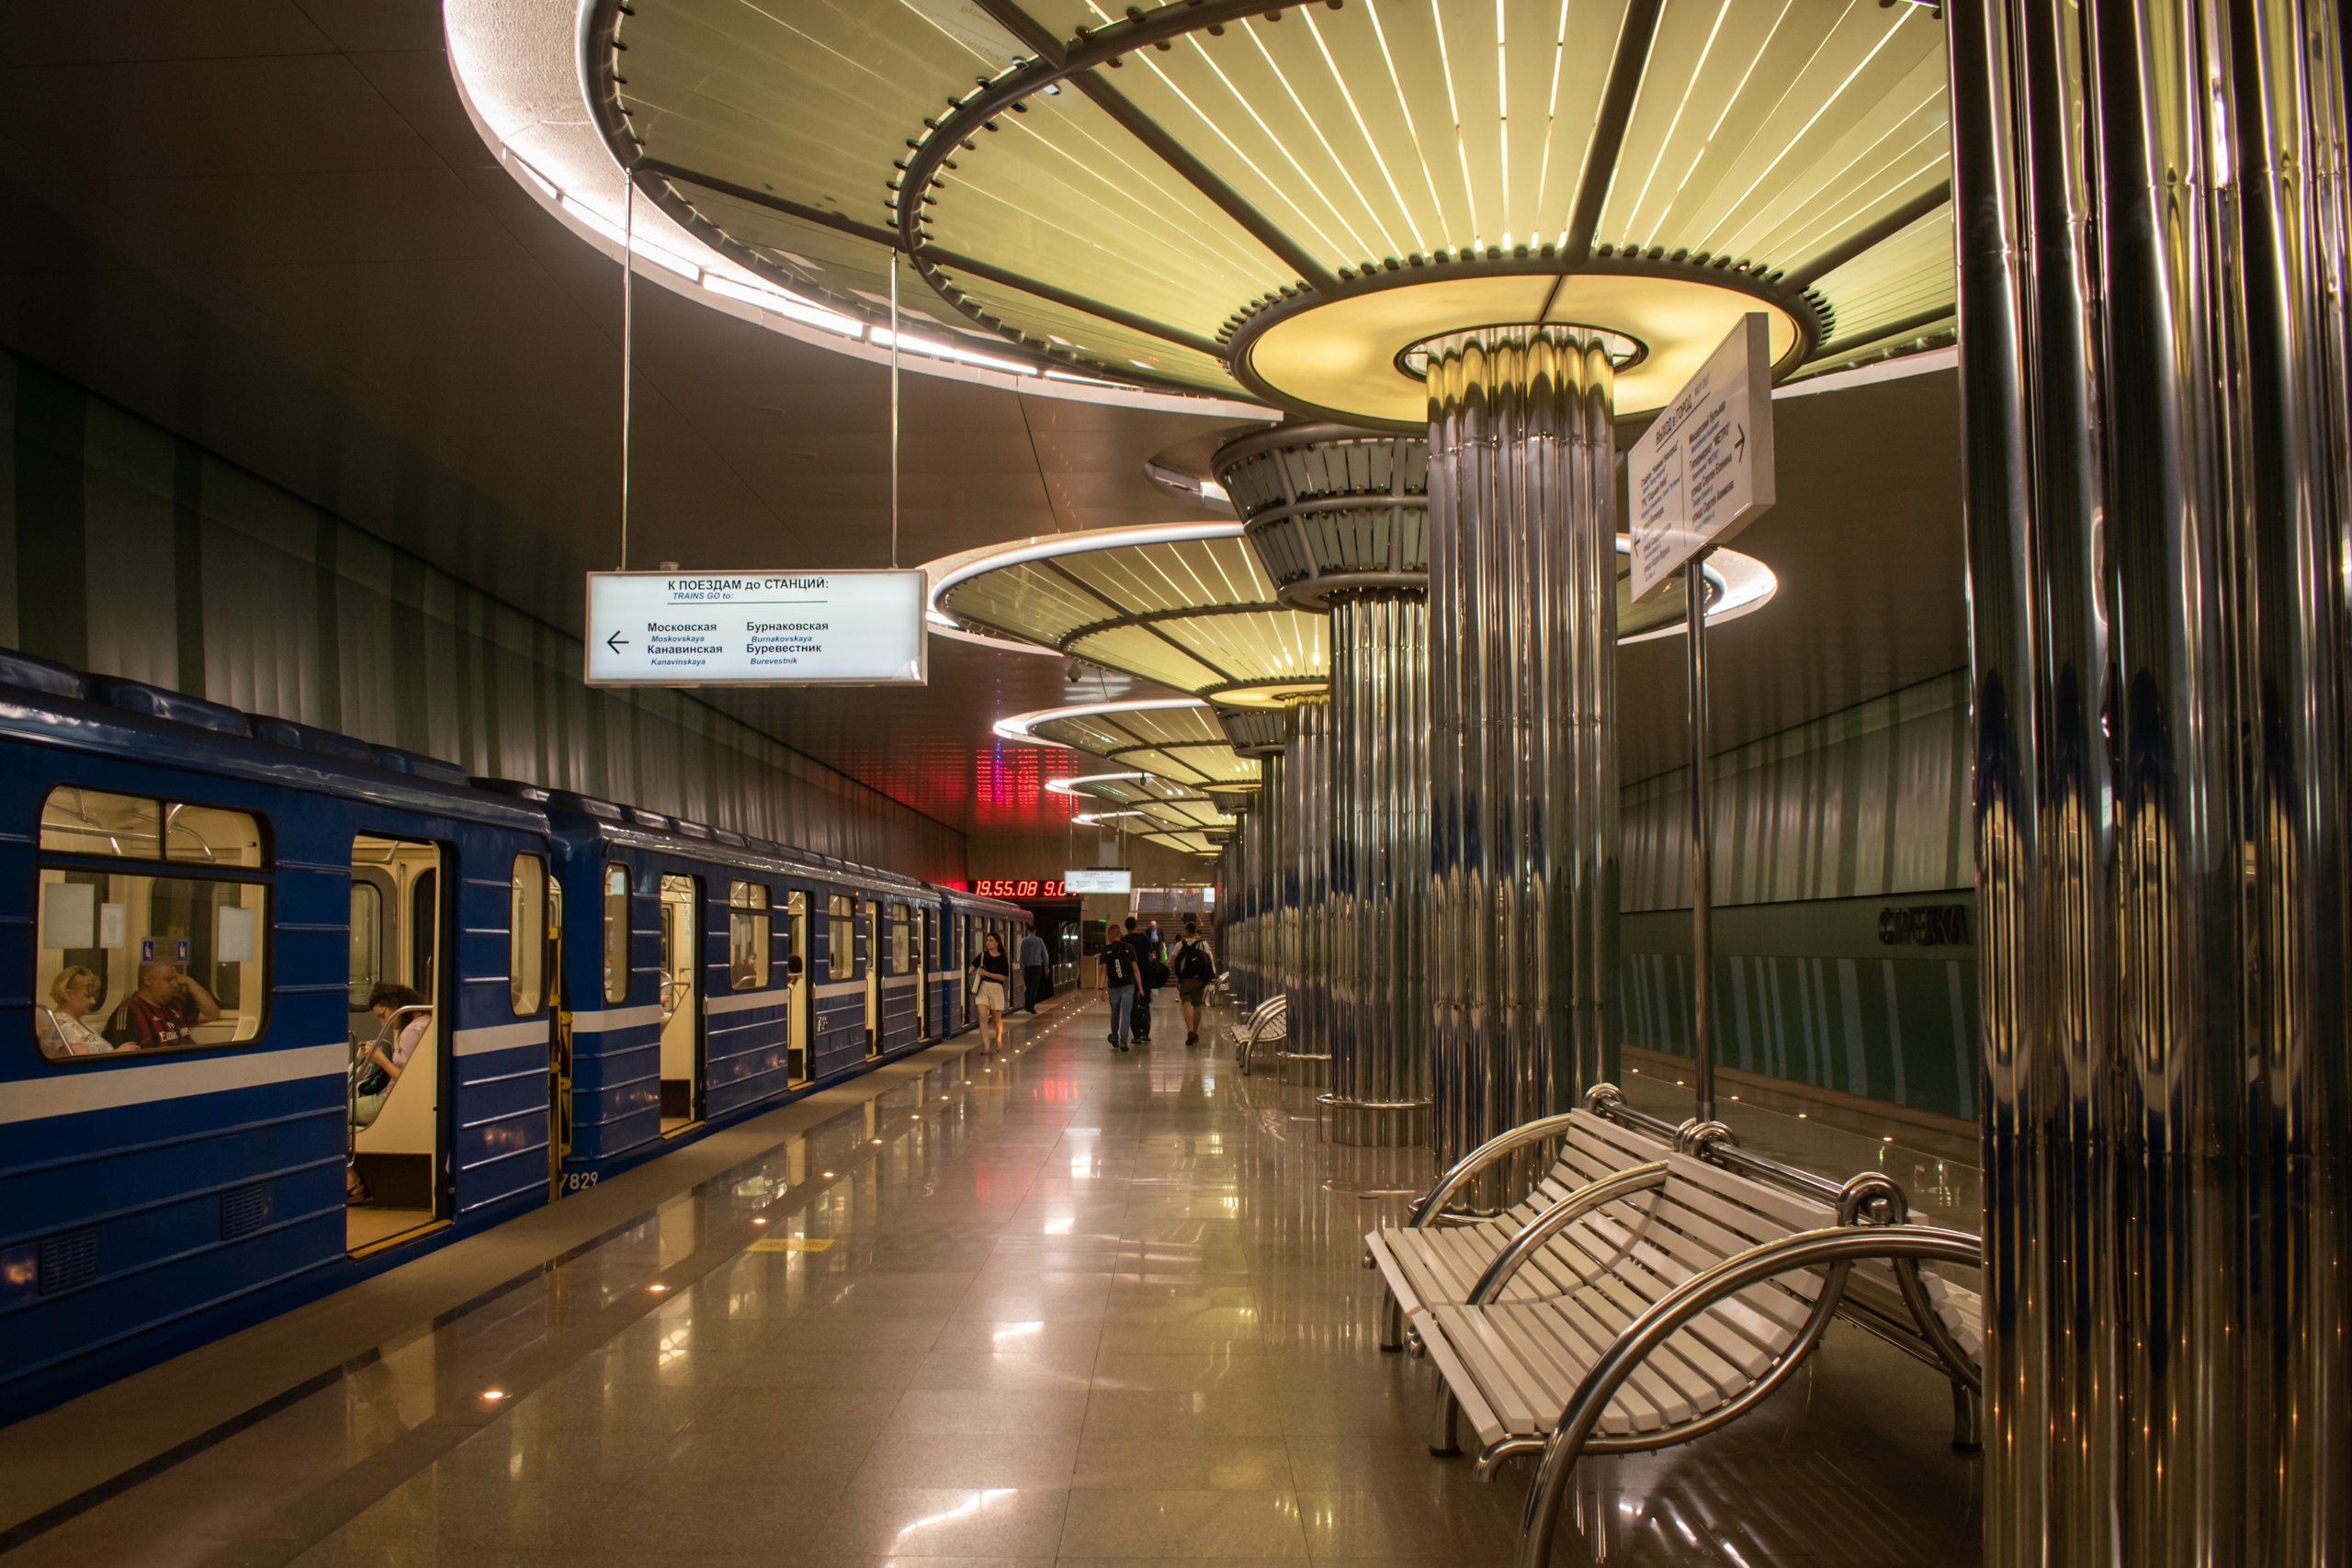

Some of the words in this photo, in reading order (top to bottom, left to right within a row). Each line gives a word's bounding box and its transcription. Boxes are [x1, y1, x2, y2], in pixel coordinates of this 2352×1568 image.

[1657, 417, 1672, 446] ВЫХОД
[1672, 416, 1675, 427] в
[1676, 394, 1692, 423] ГОРОД
[1702, 468, 1715, 487] Сергея
[1715, 453, 1732, 475] Есенина
[1703, 496, 1717, 513] Сергея
[668, 581, 676, 591] К
[679, 580, 741, 592] ПОЕЗДАМ
[744, 581, 762, 591] до
[764, 577, 829, 591] СТАНЦИЙ:
[673, 592, 705, 600] TRAINS
[707, 592, 721, 600] GO
[647, 622, 718, 632] Московская
[746, 621, 829, 634] Бурнаковская
[647, 645, 723, 654] Канавинская
[746, 643, 822, 655] Буревестник
[750, 657, 798, 665] Burevestnik
[976, 880, 1038, 897] 19.55.08
[560, 1171, 598, 1190] 7829
